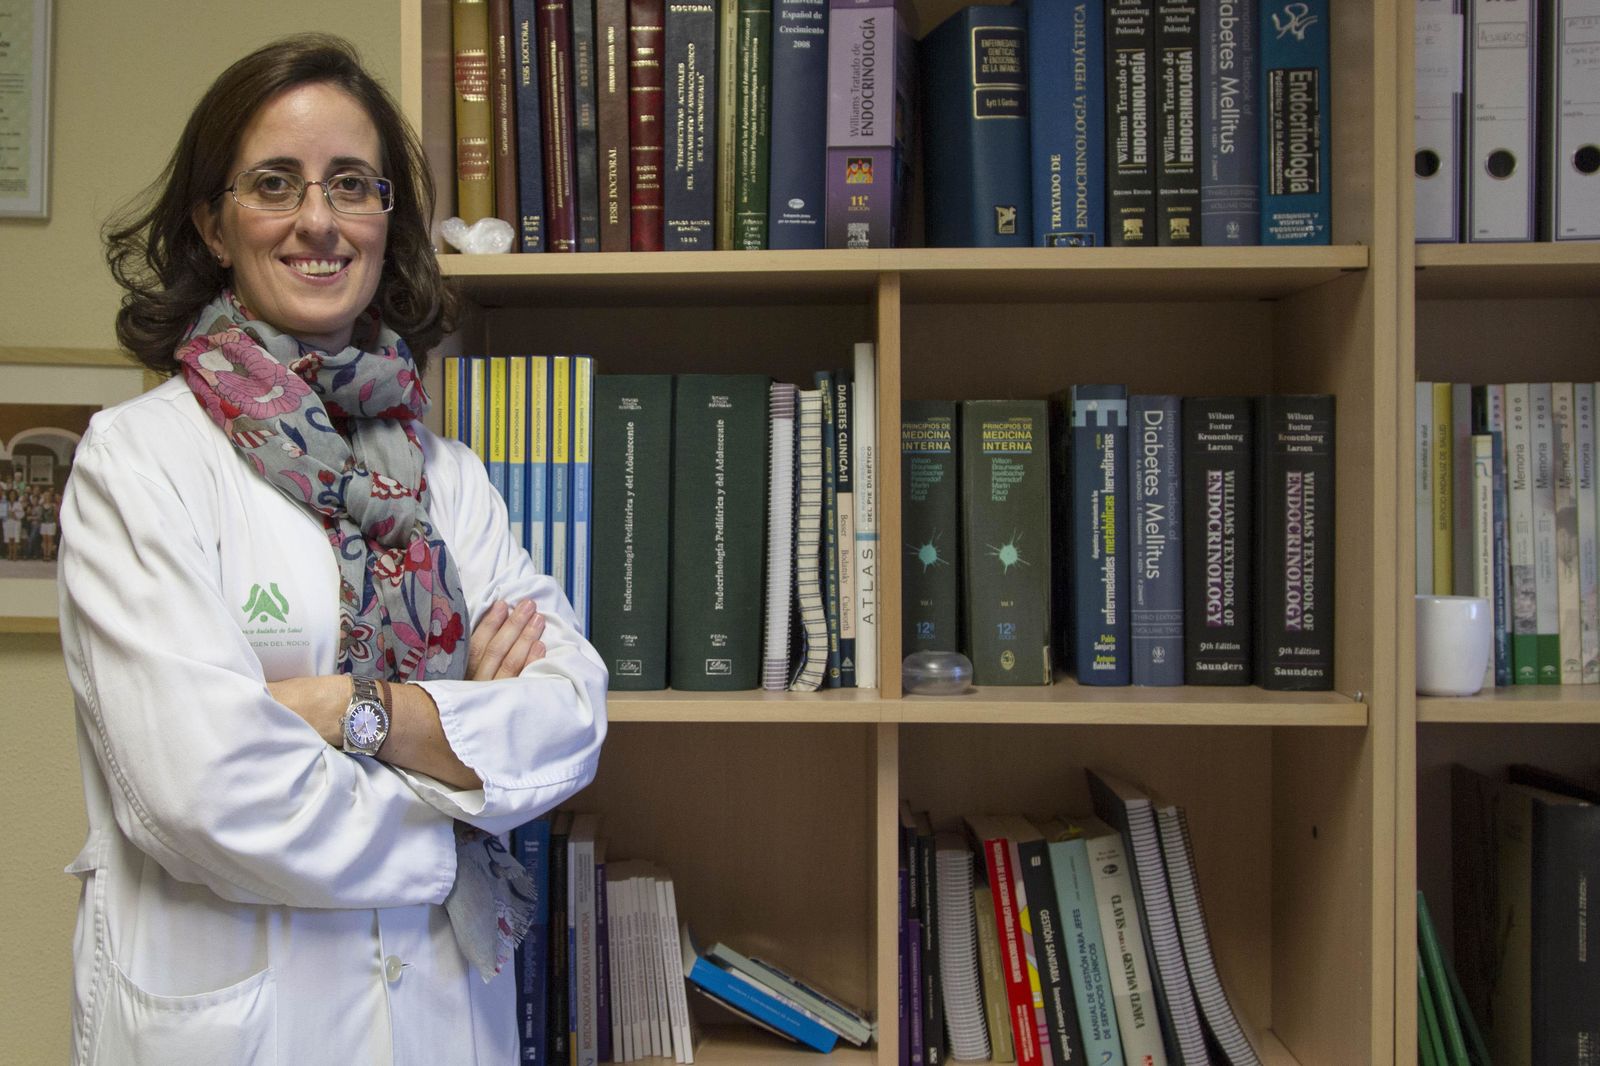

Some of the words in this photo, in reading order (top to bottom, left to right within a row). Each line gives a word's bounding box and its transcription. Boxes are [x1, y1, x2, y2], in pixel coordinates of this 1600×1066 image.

[782, 11, 813, 20] Español
[1111, 8, 1149, 16] Kronenberg
[1159, 6, 1196, 15] Kronenberg
[520, 20, 530, 63] DOCTORAL
[779, 26, 824, 34] Crecimiento
[793, 40, 810, 48] 2008
[1115, 27, 1144, 36] Polonsky
[1163, 25, 1191, 34] Polonsky
[1219, 0, 1240, 70] iabetes
[580, 41, 589, 89] DOCTORAL
[851, 44, 861, 56] de
[1072, 4, 1087, 91] PEDIÁTRICA
[1116, 53, 1127, 66] de
[1162, 51, 1174, 65] de
[522, 66, 530, 86] TESIS
[850, 58, 861, 93] Tratado
[859, 17, 875, 137] ENDOCRINOLOGÍA
[1116, 69, 1127, 113] Tratado
[1163, 68, 1174, 112] Tratado
[1275, 70, 1284, 110] Pediátrica
[850, 96, 860, 137] Williams
[1128, 52, 1147, 163] ENDOCRINOLOGÍA
[1176, 51, 1193, 162] ENDOCRINOLOGÍA
[1219, 77, 1240, 154] Mellitus
[1276, 119, 1284, 129] de
[687, 115, 695, 172] TRATAMIENTO
[1117, 115, 1128, 163] Williams
[1163, 115, 1175, 162] Williams
[1285, 71, 1313, 193] Endocrinología
[608, 147, 618, 199] DOCTORAL
[1051, 154, 1061, 171] DE
[1072, 95, 1087, 228] ENDOCRINOLOGÍA
[1276, 141, 1285, 194] Adolescencia
[687, 174, 695, 190] DEL
[609, 202, 618, 224] TESIS
[1052, 174, 1061, 229] TRATADO
[838, 384, 848, 429] DIABETES
[1208, 412, 1235, 420] Wilson
[1514, 397, 1522, 430] 2000
[902, 431, 951, 439] MEDICINA
[983, 431, 1032, 439] MEDICINA
[1198, 433, 1244, 442] Kronenberg
[1209, 422, 1233, 430] Foster
[1279, 433, 1324, 443] Kronenberg
[1288, 423, 1312, 431] Foster
[1439, 424, 1447, 448] SALUD
[625, 422, 635, 473] Adolescente
[716, 419, 725, 471] Adolescente
[838, 432, 849, 482] CLINICA-II
[902, 441, 951, 450] INTERNA
[983, 441, 1032, 450] INTERNA
[1144, 410, 1164, 496] Diabetes
[1208, 443, 1233, 451] Larsen
[1287, 444, 1313, 452] Larsen
[1439, 451, 1447, 461] DE
[715, 473, 725, 487] del
[1100, 433, 1114, 493] hereditarias
[1439, 462, 1448, 495] ANDALUZ
[1513, 443, 1526, 490] Memoria
[1536, 442, 1548, 489] Memoria
[1559, 442, 1571, 489] Memoria
[1580, 443, 1590, 489] Memoria
[625, 476, 634, 489] del
[1224, 470, 1235, 533] WILLIAMS
[1304, 471, 1315, 537] WILLIAMS
[1439, 496, 1448, 530] SERVICIO
[624, 498, 634, 543] Pediátrica
[715, 497, 725, 542] Pediátrica
[840, 514, 848, 537] Besser
[1101, 495, 1115, 555] metabólicas
[1146, 502, 1165, 579] Mellitus
[1207, 470, 1222, 625] ENDOCRINOLOGY
[1286, 471, 1302, 631] ENDOCRINOLOGY
[623, 545, 635, 611] Endocrinología
[715, 543, 726, 610] Endocrinología
[841, 550, 850, 585] Bodansky
[1224, 537, 1235, 606] TEXTBOOK
[1304, 540, 1315, 610] TEXTBOOK
[862, 548, 873, 625] ATLAS
[1101, 556, 1115, 624] enfermedades
[841, 596, 850, 631] Cudworth
[1224, 609, 1235, 626] OF
[1304, 613, 1315, 631] OF
[1100, 634, 1115, 643] Pablo
[1200, 642, 1213, 652] 9th
[1215, 642, 1240, 650] Edition
[1278, 647, 1292, 657] 9th
[1294, 647, 1320, 655] Edition
[1195, 661, 1243, 671] Saunders
[1274, 666, 1323, 676] Saunders
[582, 912, 590, 945] MEDICINA
[1039, 908, 1053, 943] GESTIÓN
[1073, 908, 1083, 930] JEFES
[1110, 893, 1127, 929] CLAVES
[1077, 931, 1086, 953] PARA
[1045, 943, 1058, 983] SANITARIA
[1079, 955, 1092, 989] GESTIÓN
[1088, 942, 1101, 983] CLÍNICOS
[1121, 952, 1139, 991] GESTIÓN
[1053, 986, 1064, 1028] Innovaciones
[1086, 991, 1095, 1002] DE
[1096, 983, 1109, 1027] SERVICIOS
[1128, 991, 1146, 1029] CLÍNICA
[1090, 1004, 1102, 1040] MANUAL
[1102, 1028, 1111, 1039] DE
[1061, 1033, 1071, 1061] desafíos
